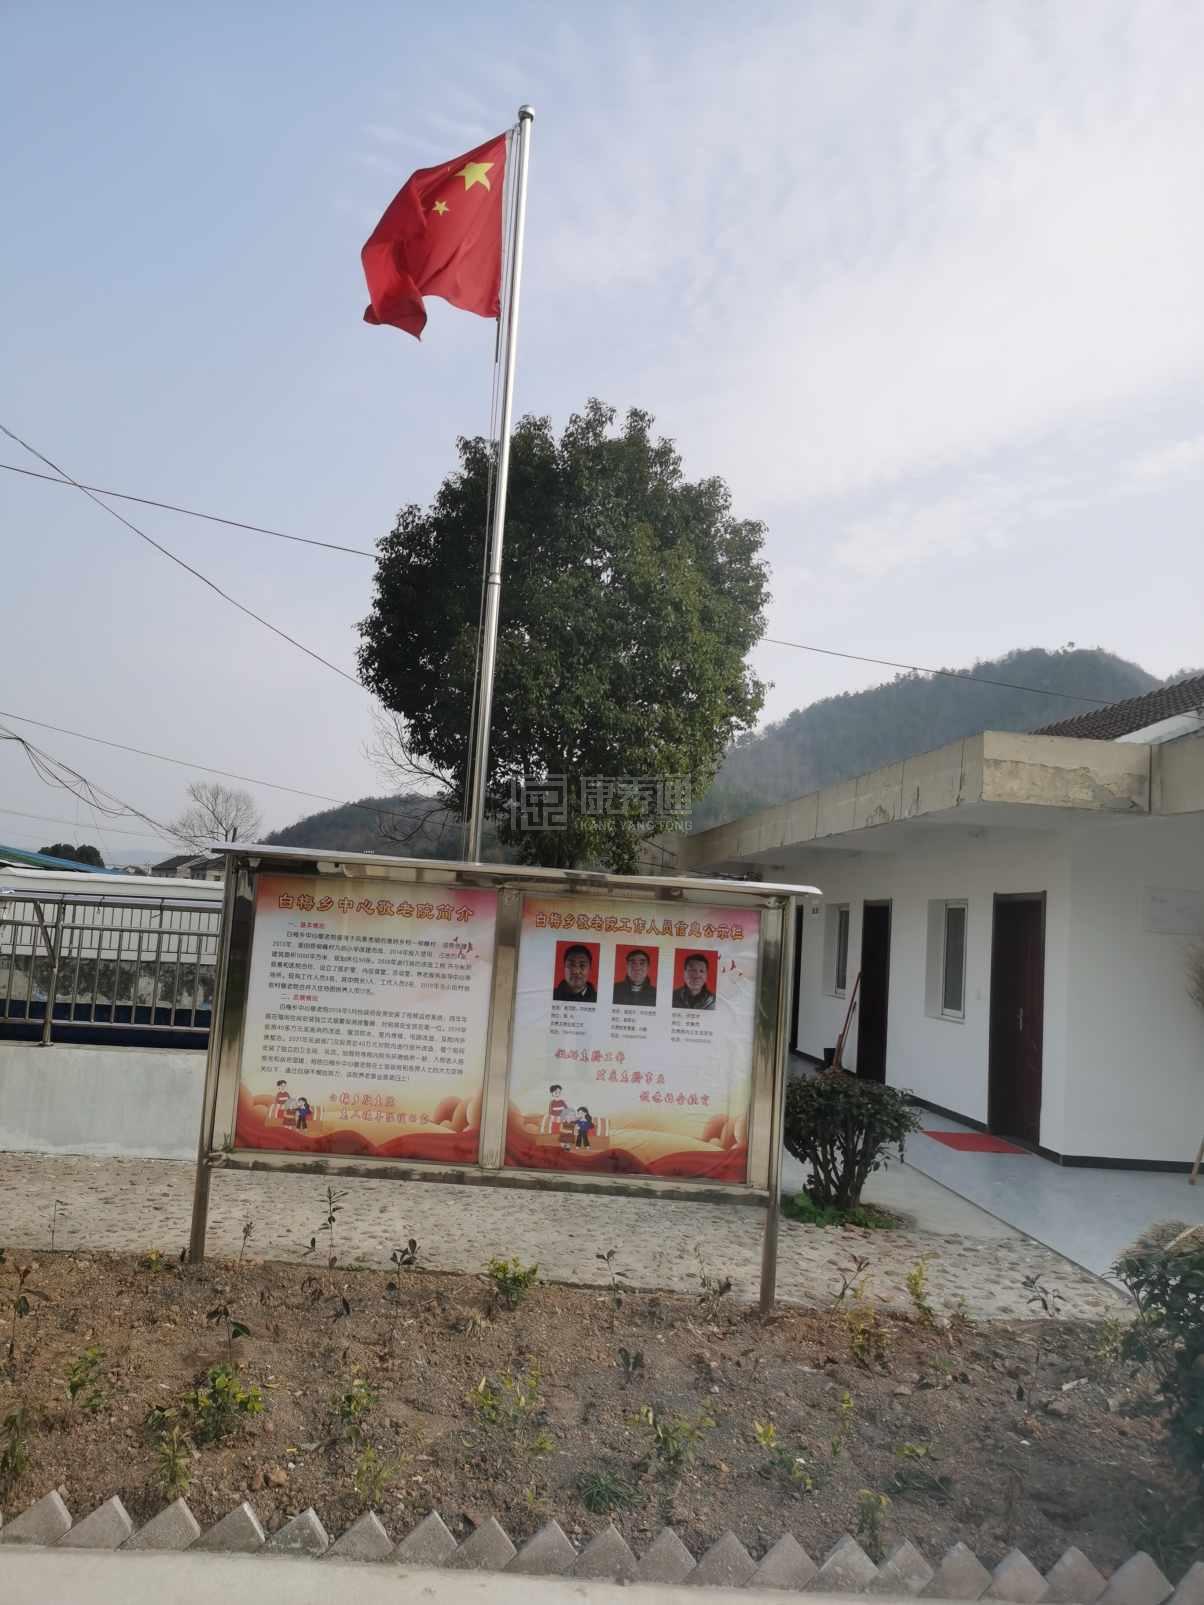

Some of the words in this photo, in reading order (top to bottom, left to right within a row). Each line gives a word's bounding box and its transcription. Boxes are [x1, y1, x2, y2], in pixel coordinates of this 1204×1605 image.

[277, 892, 474, 922] 白梅乡中心敬老院简介
[534, 911, 745, 941] 白梅乡敬老院工作人员信息公示栏
